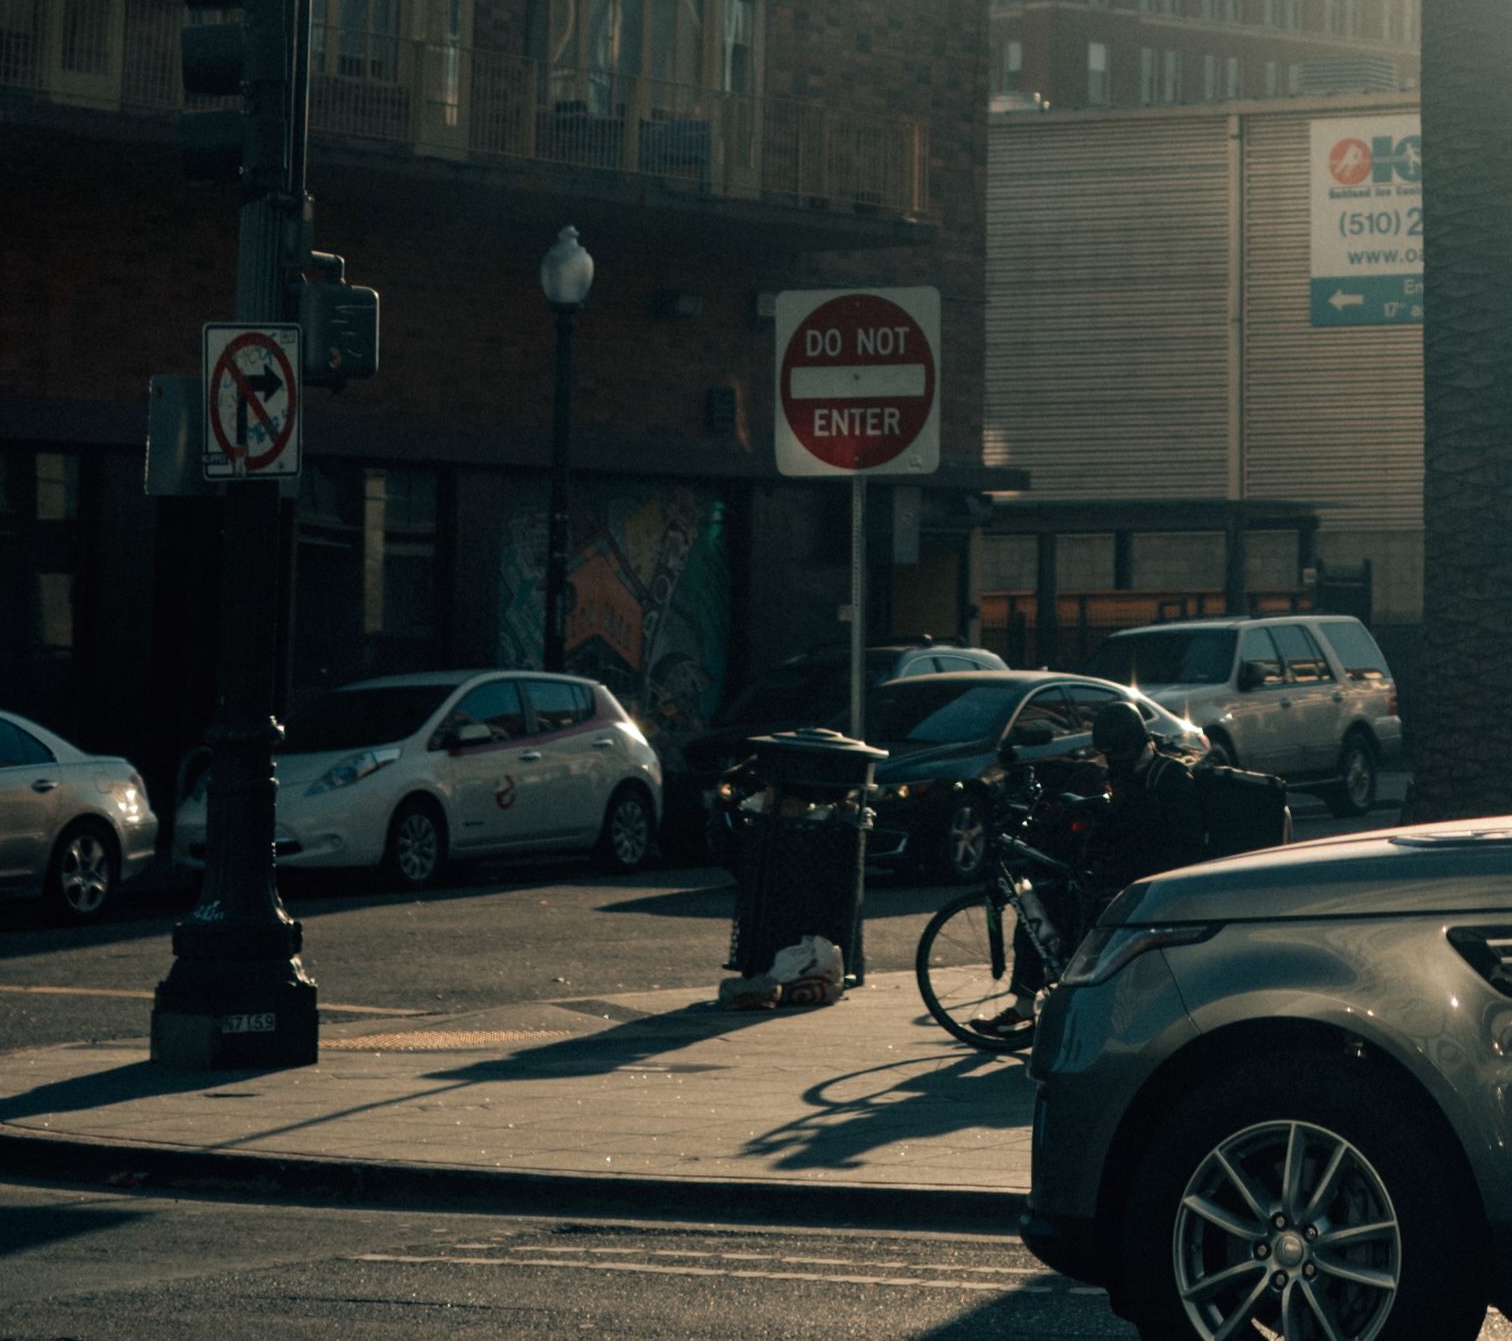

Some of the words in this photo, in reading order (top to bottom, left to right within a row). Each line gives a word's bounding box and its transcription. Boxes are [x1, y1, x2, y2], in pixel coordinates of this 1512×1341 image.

[1339, 210, 1401, 237] (510)
[805, 329, 842, 357] DO
[856, 327, 910, 355] NOT
[813, 407, 901, 437] ENTER
